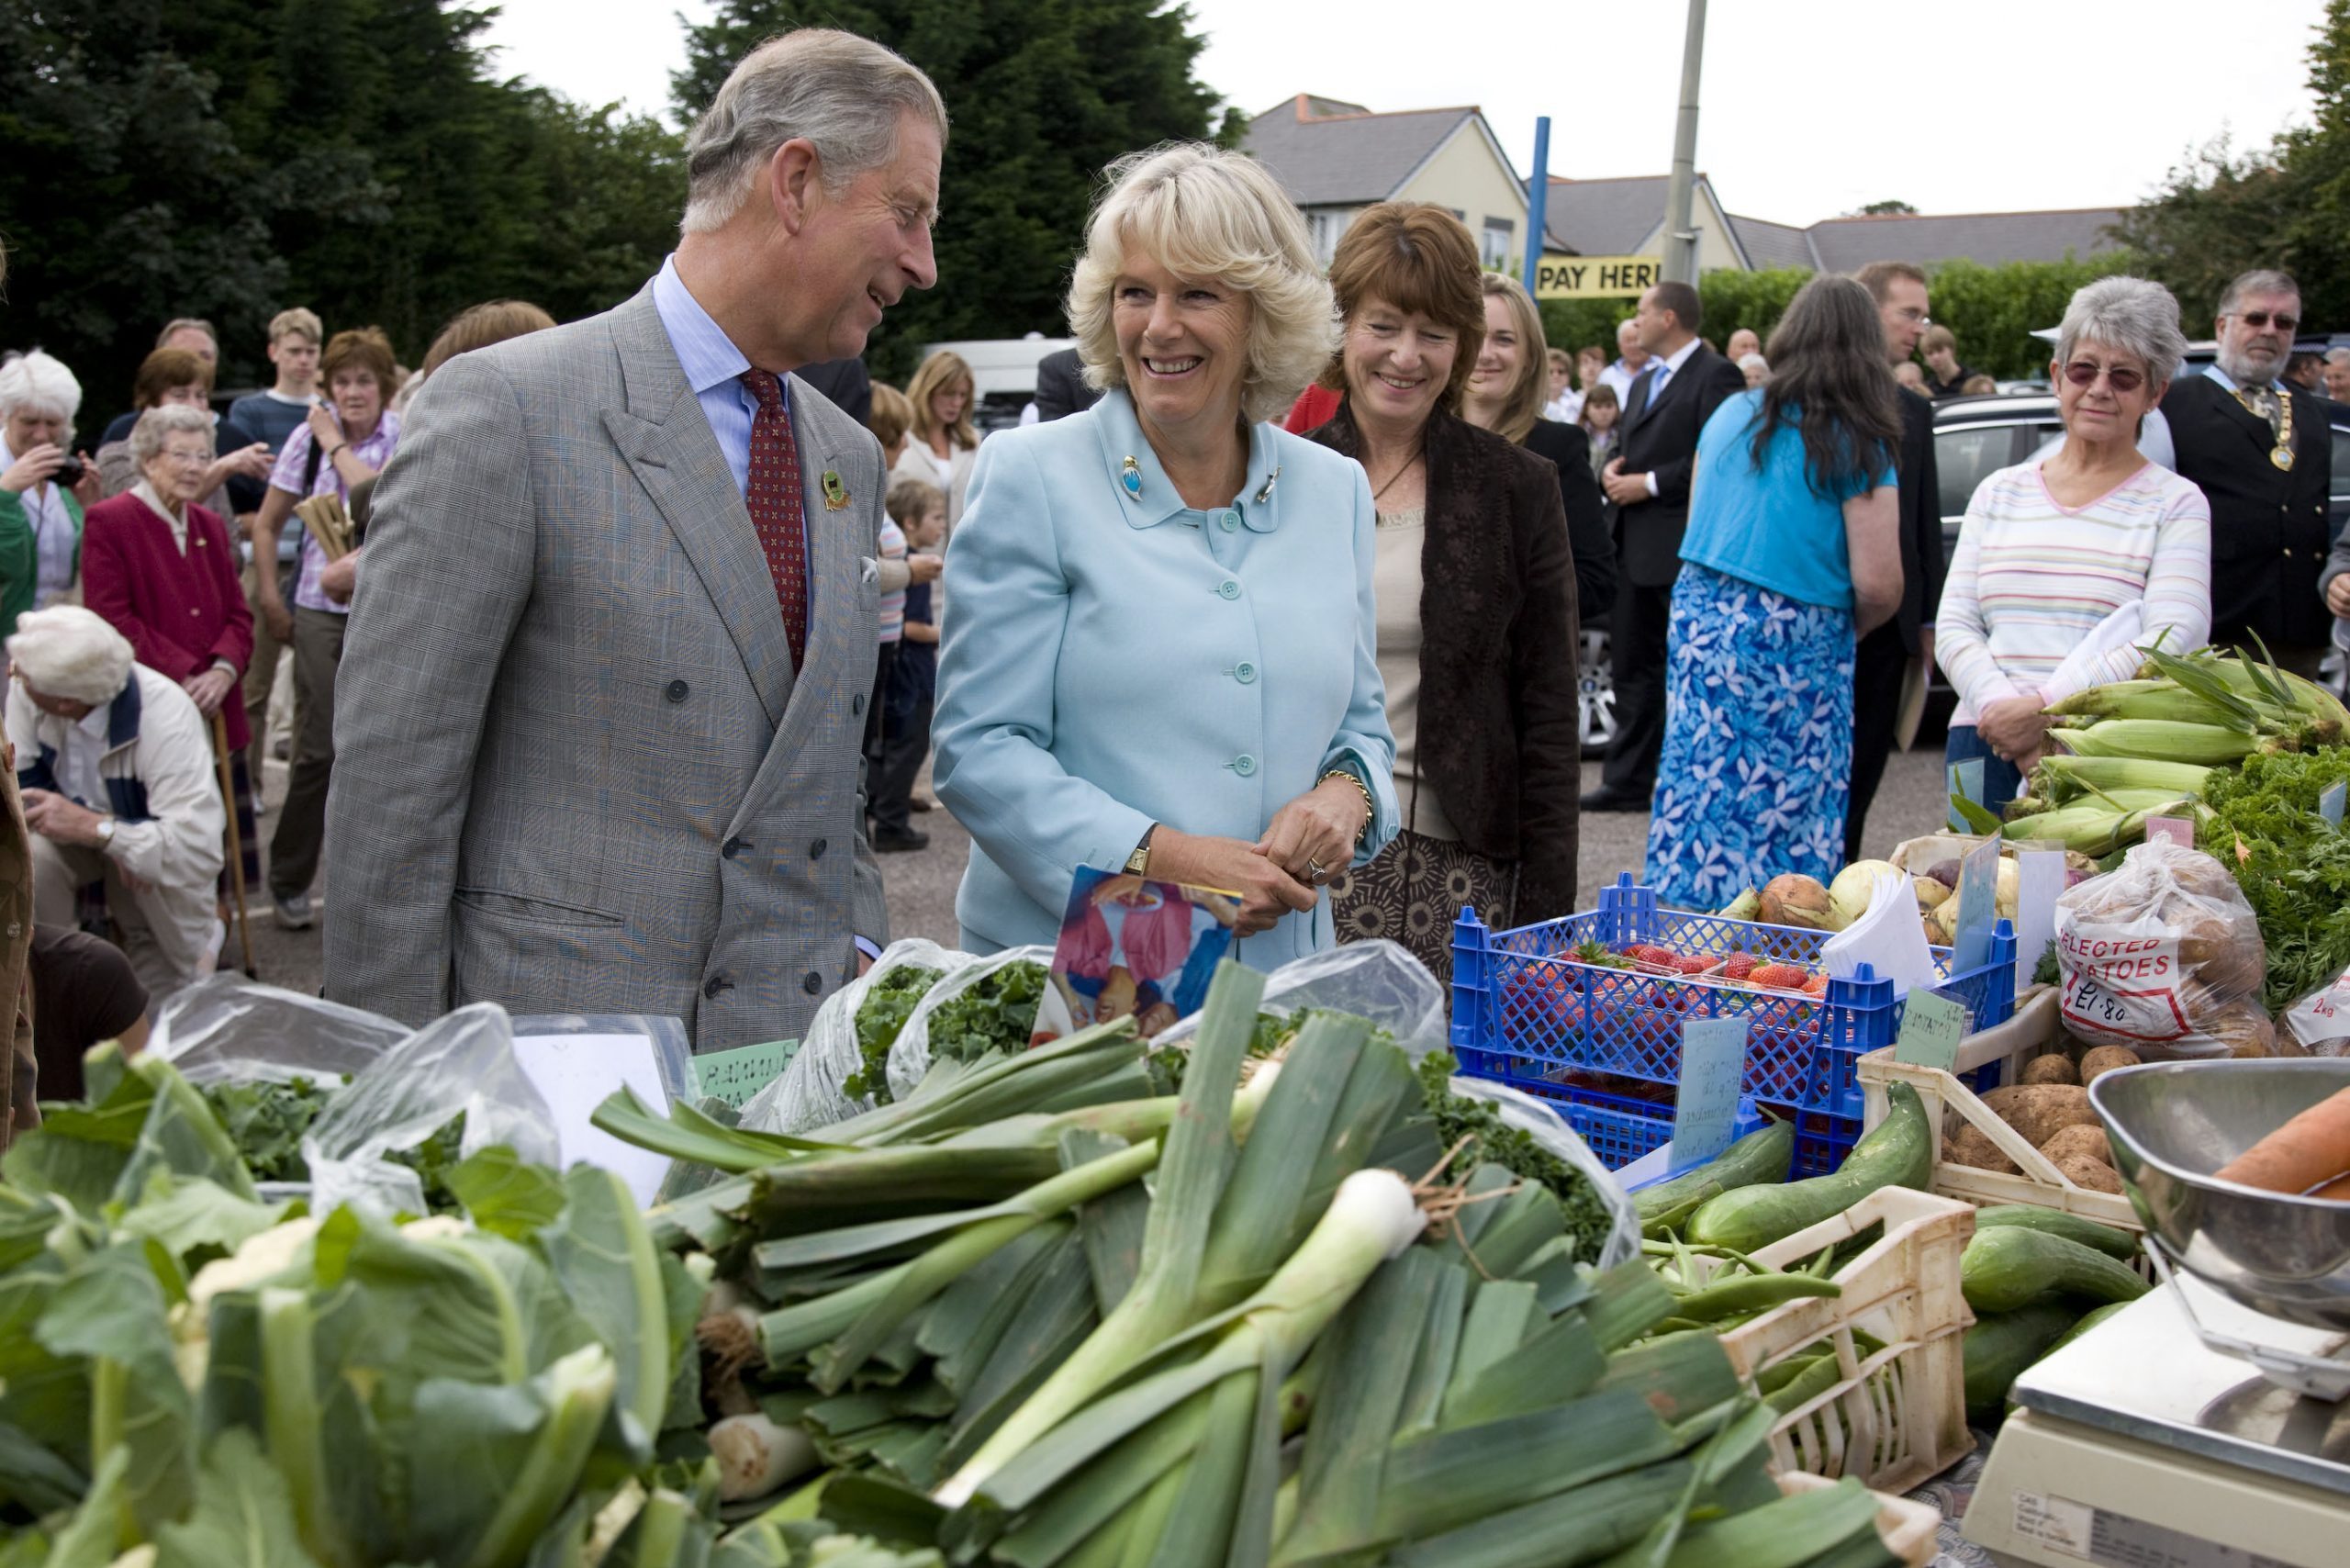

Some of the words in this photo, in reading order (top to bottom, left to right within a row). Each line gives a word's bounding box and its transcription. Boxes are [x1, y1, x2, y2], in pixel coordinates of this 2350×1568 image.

[1539, 265, 1587, 291] PAY
[2060, 928, 2161, 958] ELECTED
[2074, 955, 2170, 981] TATOES
[2312, 997, 2334, 1018] 2kg
